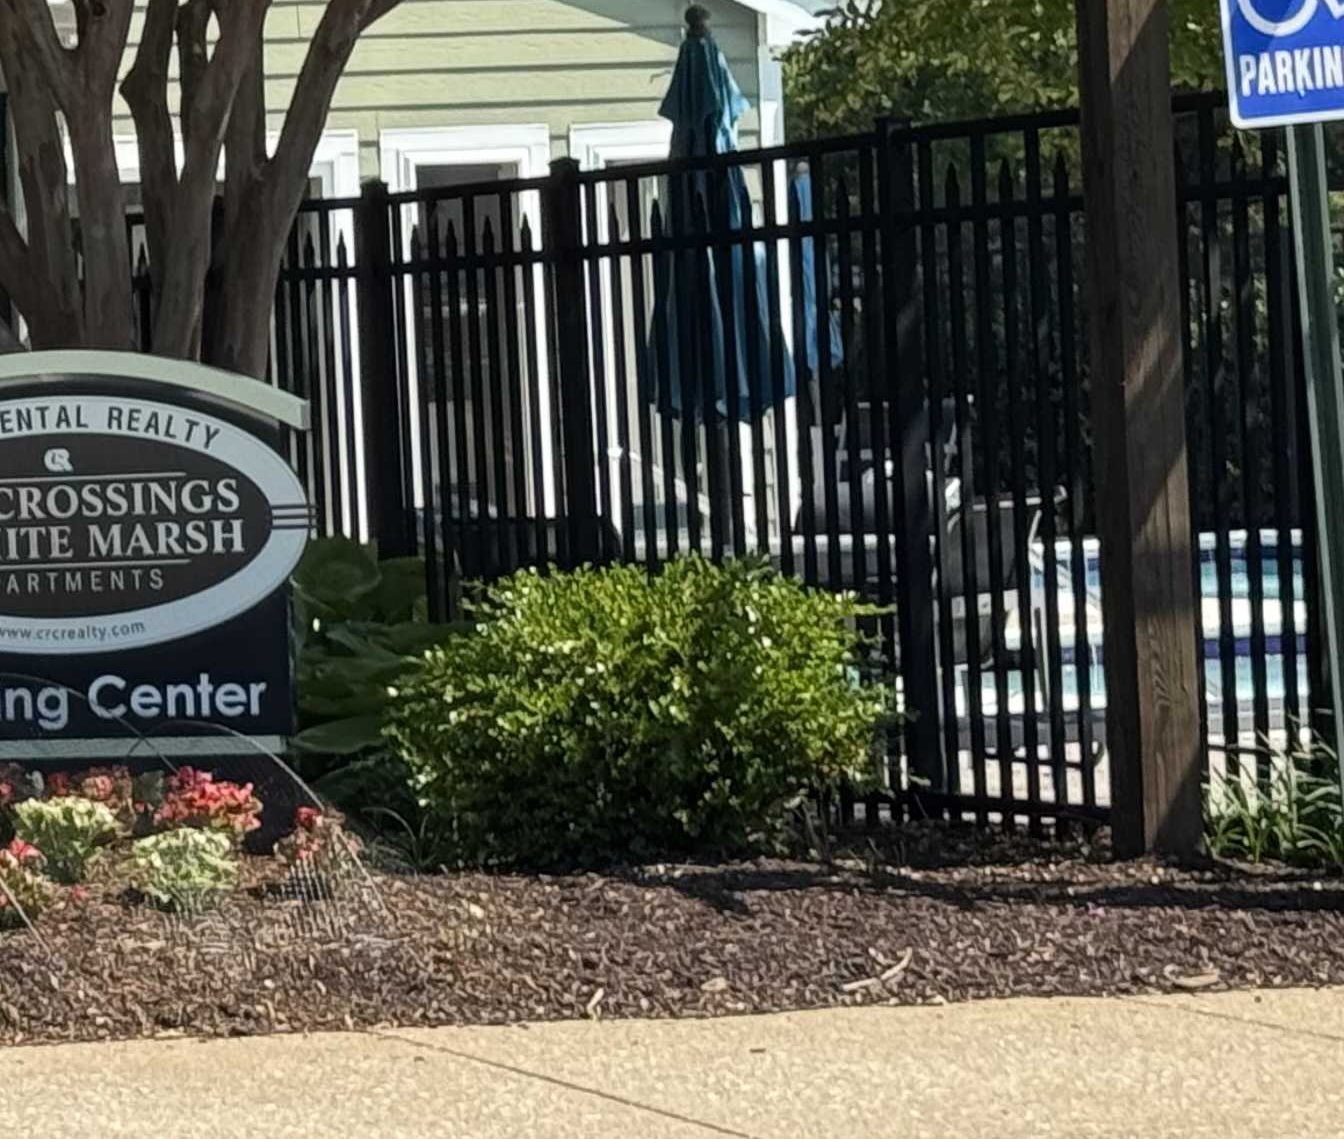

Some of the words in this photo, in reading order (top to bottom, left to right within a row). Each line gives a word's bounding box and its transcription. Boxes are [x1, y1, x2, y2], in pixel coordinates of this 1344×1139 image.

[1239, 45, 1344, 97] PARKIN
[107, 405, 221, 450] REALTY
[88, 519, 244, 557] MARSH
[88, 674, 266, 718] Center
